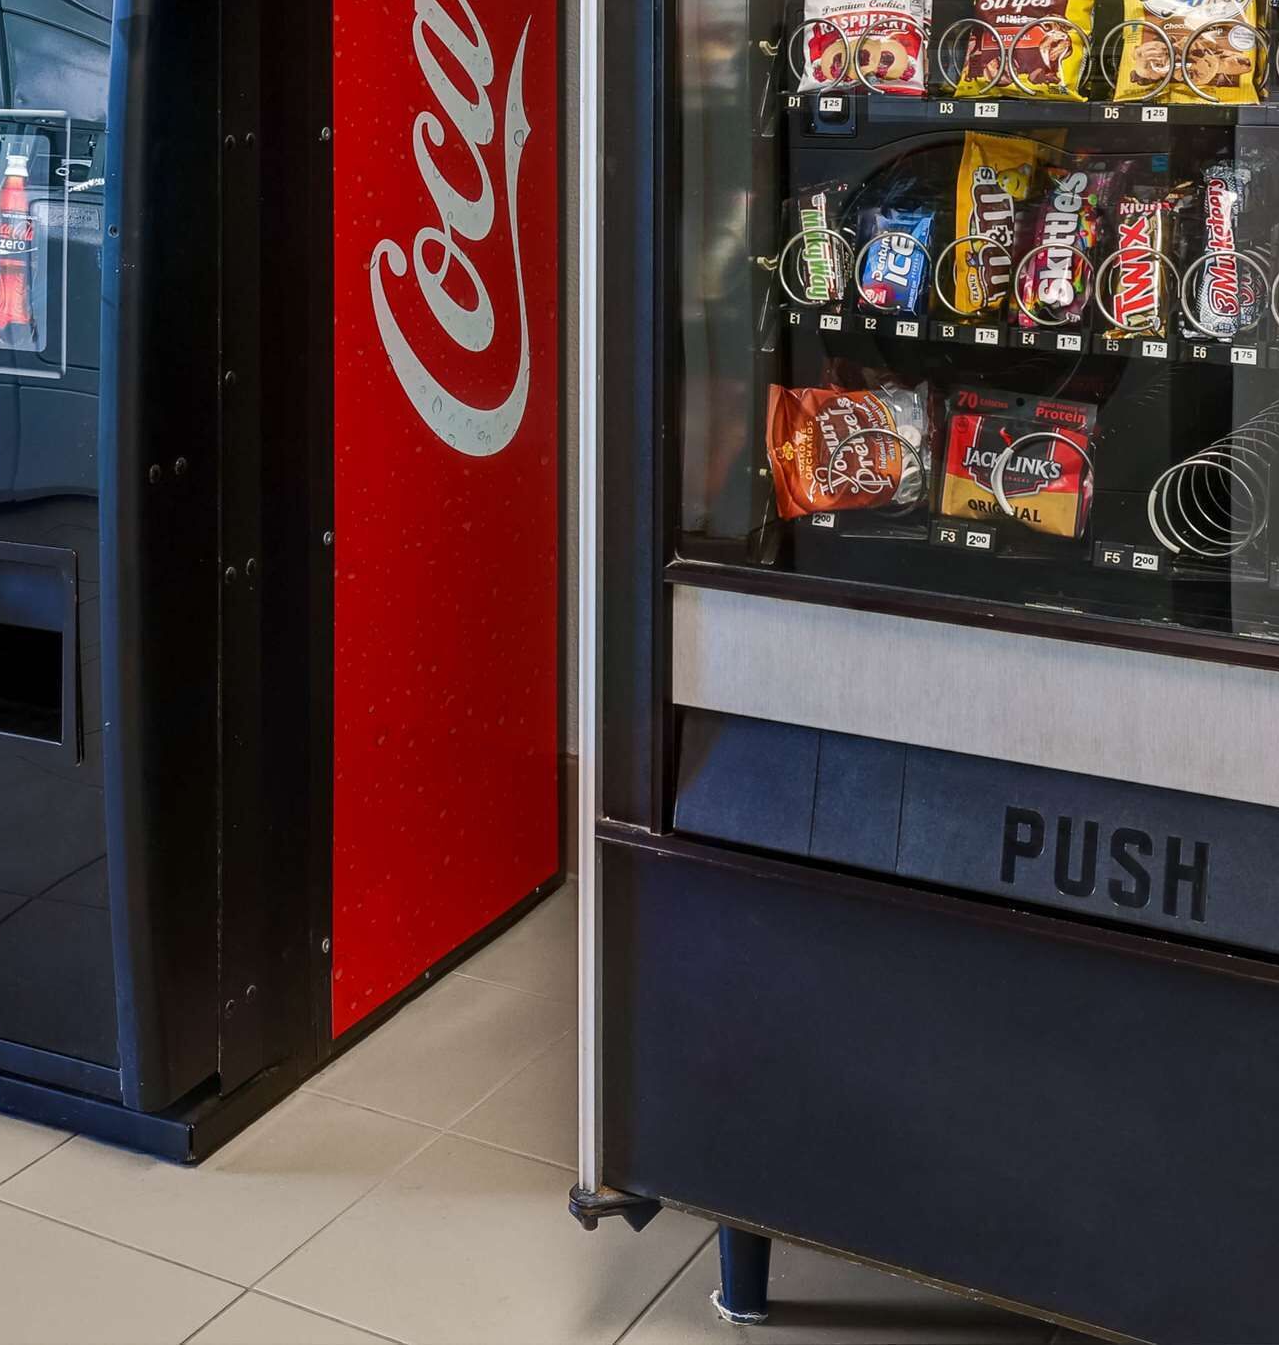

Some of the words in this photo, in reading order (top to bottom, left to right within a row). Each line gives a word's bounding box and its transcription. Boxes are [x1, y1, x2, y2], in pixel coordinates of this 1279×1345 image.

[822, 1, 864, 16] Premium
[789, 96, 801, 108] D1
[1104, 107, 1119, 119] D5
[0, 239, 25, 250] zero
[883, 235, 915, 287] ICE
[1114, 218, 1155, 324] TWIX
[970, 274, 979, 302] PEANUT
[1022, 333, 1034, 345] E4
[1193, 347, 1207, 358] E6
[959, 392, 978, 408] 70
[1035, 407, 1087, 424] Protein
[1104, 552, 1120, 563] F5
[1000, 805, 1210, 924] PUSH
